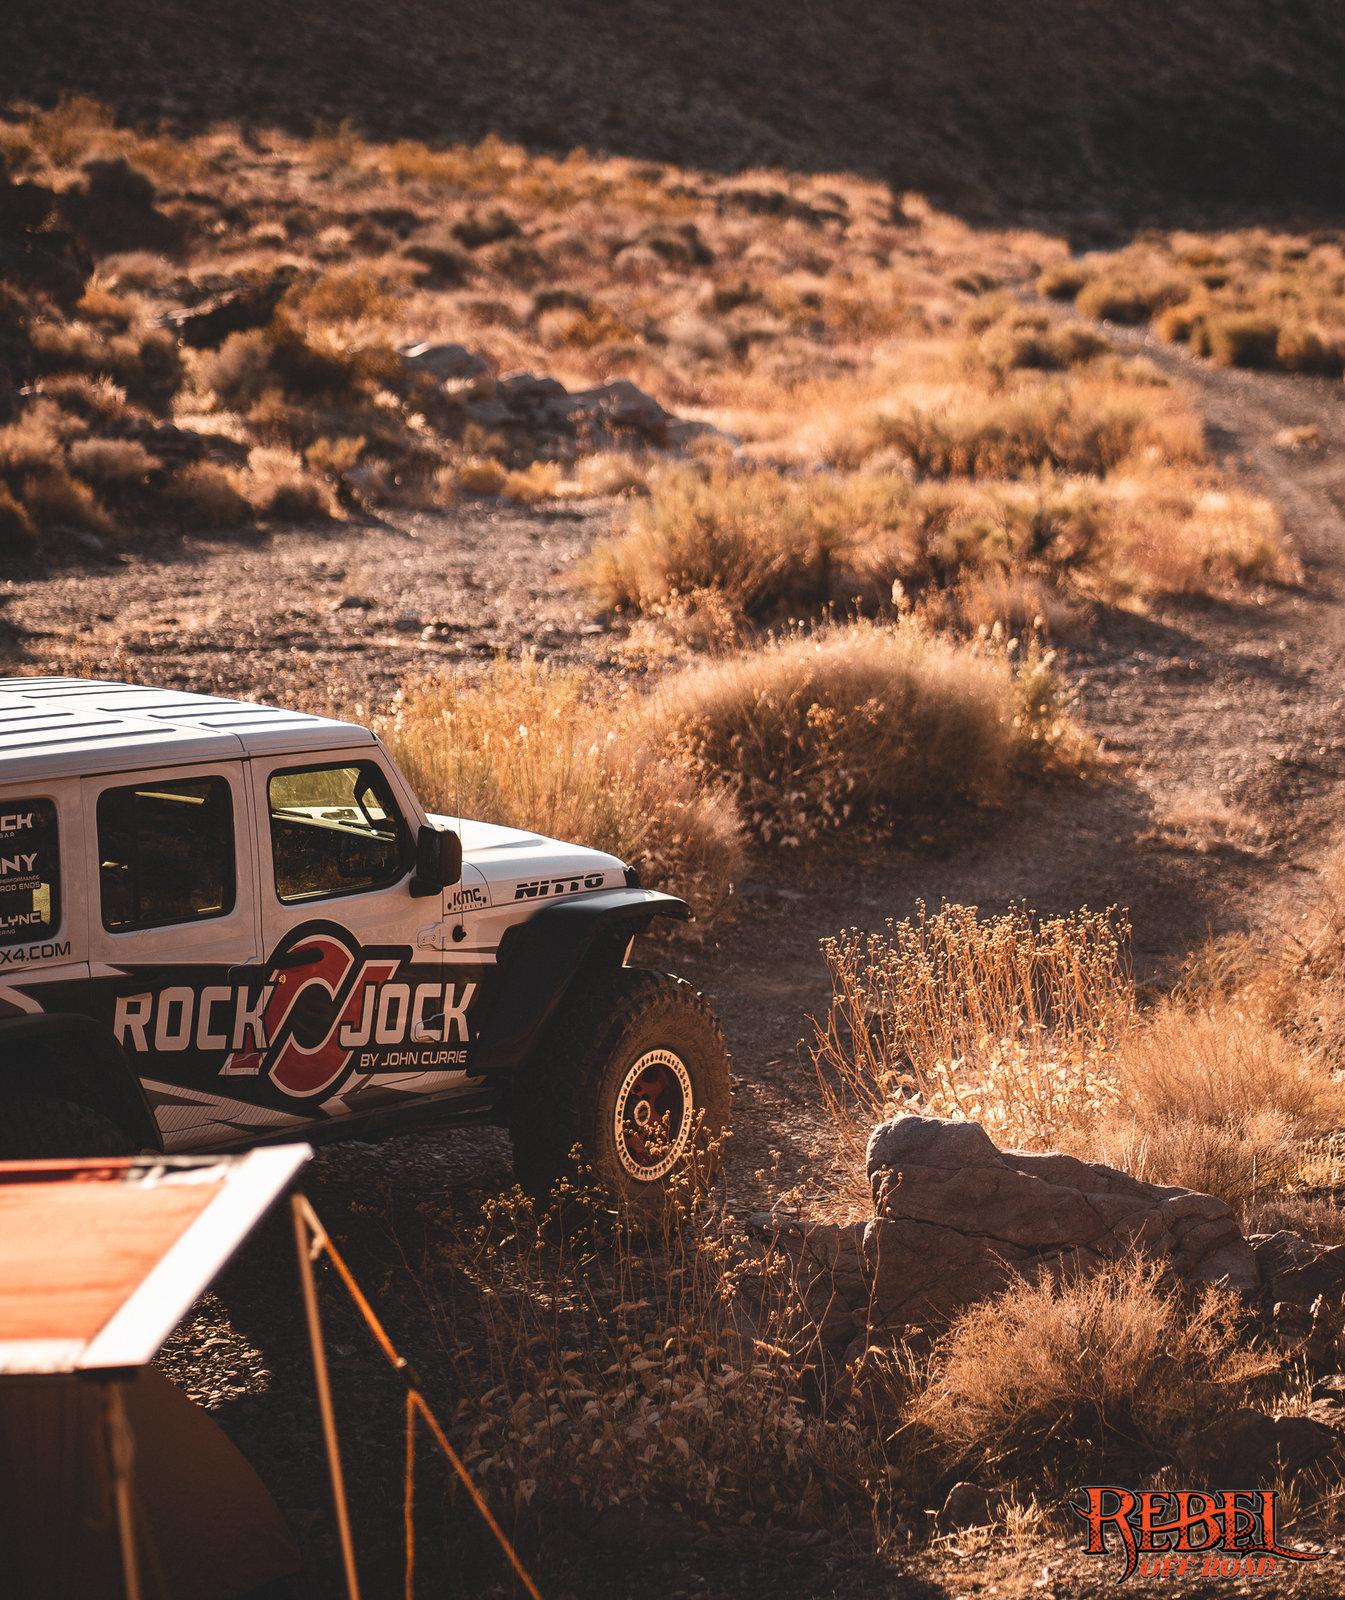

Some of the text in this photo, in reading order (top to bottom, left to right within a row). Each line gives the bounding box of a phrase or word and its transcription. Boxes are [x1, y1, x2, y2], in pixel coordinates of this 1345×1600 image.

[0, 852, 38, 875] NY
[19, 881, 41, 890] ENDS
[514, 873, 605, 899] NITTO
[114, 982, 477, 1052] ROCK JOCK
[360, 1050, 467, 1067] BY JOHN CURRIE
